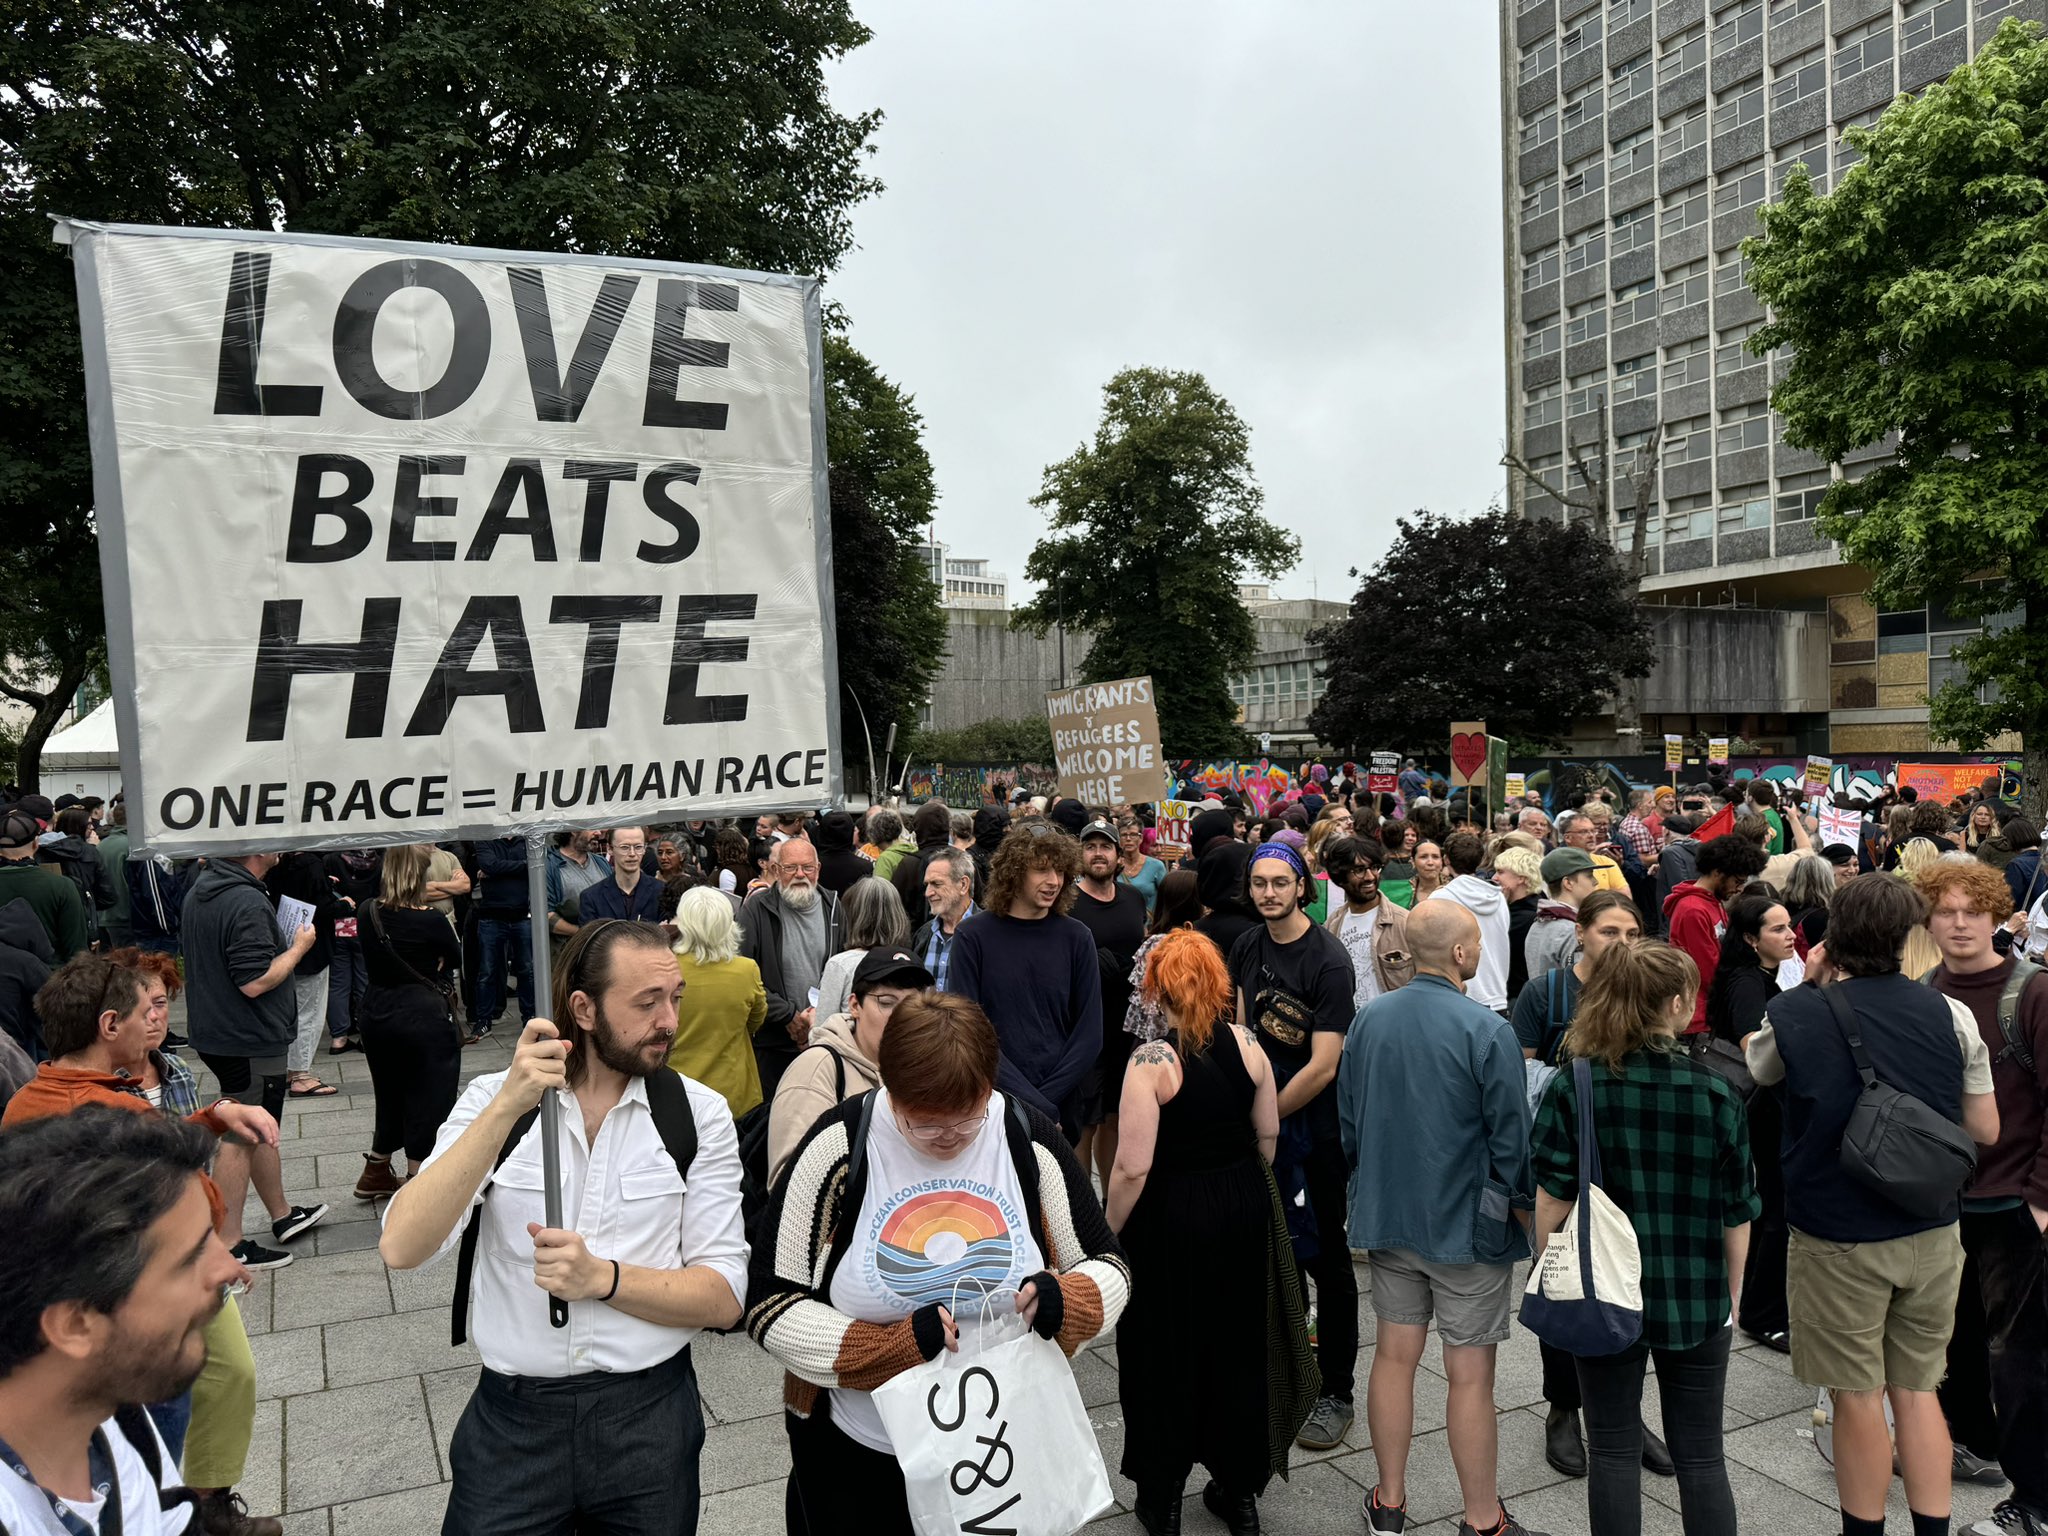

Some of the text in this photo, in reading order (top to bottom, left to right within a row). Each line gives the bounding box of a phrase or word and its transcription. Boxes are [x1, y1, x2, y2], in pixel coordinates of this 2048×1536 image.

[213, 251, 741, 431] LOVE
[286, 453, 702, 564] BEATS
[246, 593, 759, 743] HATE
[1047, 679, 1150, 719] IMMIGRANTS
[1055, 719, 1141, 752] REFUGEES
[1055, 743, 1154, 777] WELCOME
[1369, 766, 1397, 775] PALESTINE
[1372, 757, 1398, 765] FREEDOM
[1807, 761, 1831, 772] Refugees
[1954, 768, 1991, 776] WELFARE
[160, 748, 828, 830] ONE RACE = HUMAN RACE
[1076, 775, 1125, 805] HERE
[1953, 775, 1972, 783] NOT
[1160, 801, 1188, 819] NO
[1156, 816, 1193, 844] RACIS
[869, 1178, 1022, 1240] OCEAN CONSERVATION TRUST
[862, 1246, 880, 1292] TRUST
[1009, 1232, 1026, 1288] OCEAN
